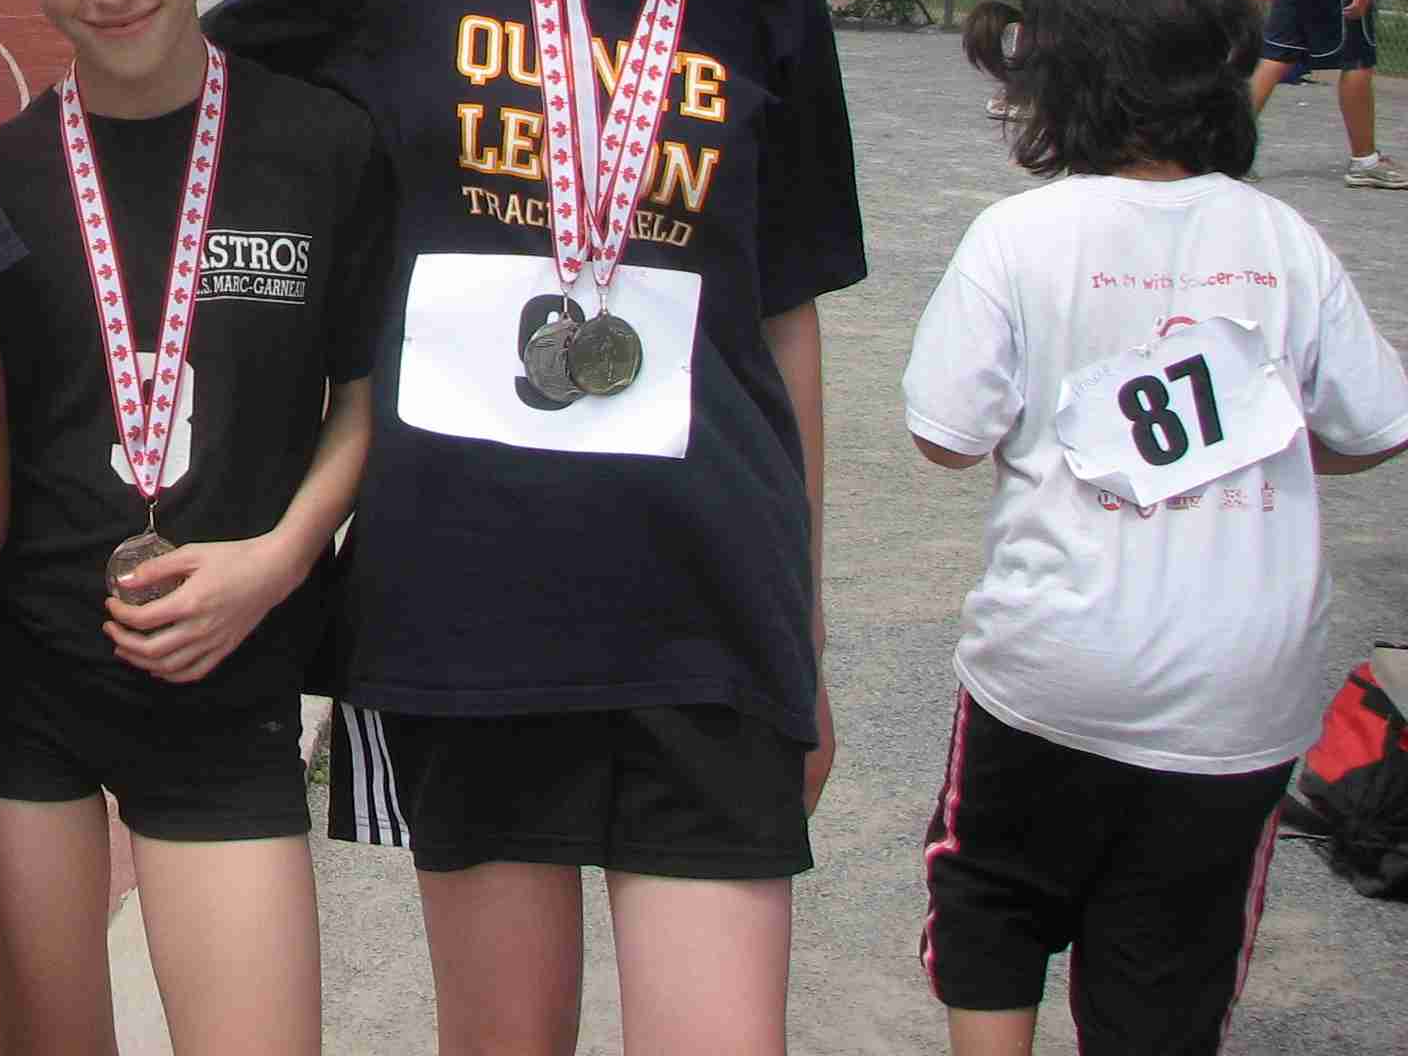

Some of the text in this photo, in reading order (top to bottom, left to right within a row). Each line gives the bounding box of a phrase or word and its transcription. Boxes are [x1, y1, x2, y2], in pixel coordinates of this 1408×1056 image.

[456, 14, 727, 123] QUNE
[456, 103, 720, 213] LEN
[461, 184, 552, 229] TRAC
[1117, 352, 1225, 467] 87
